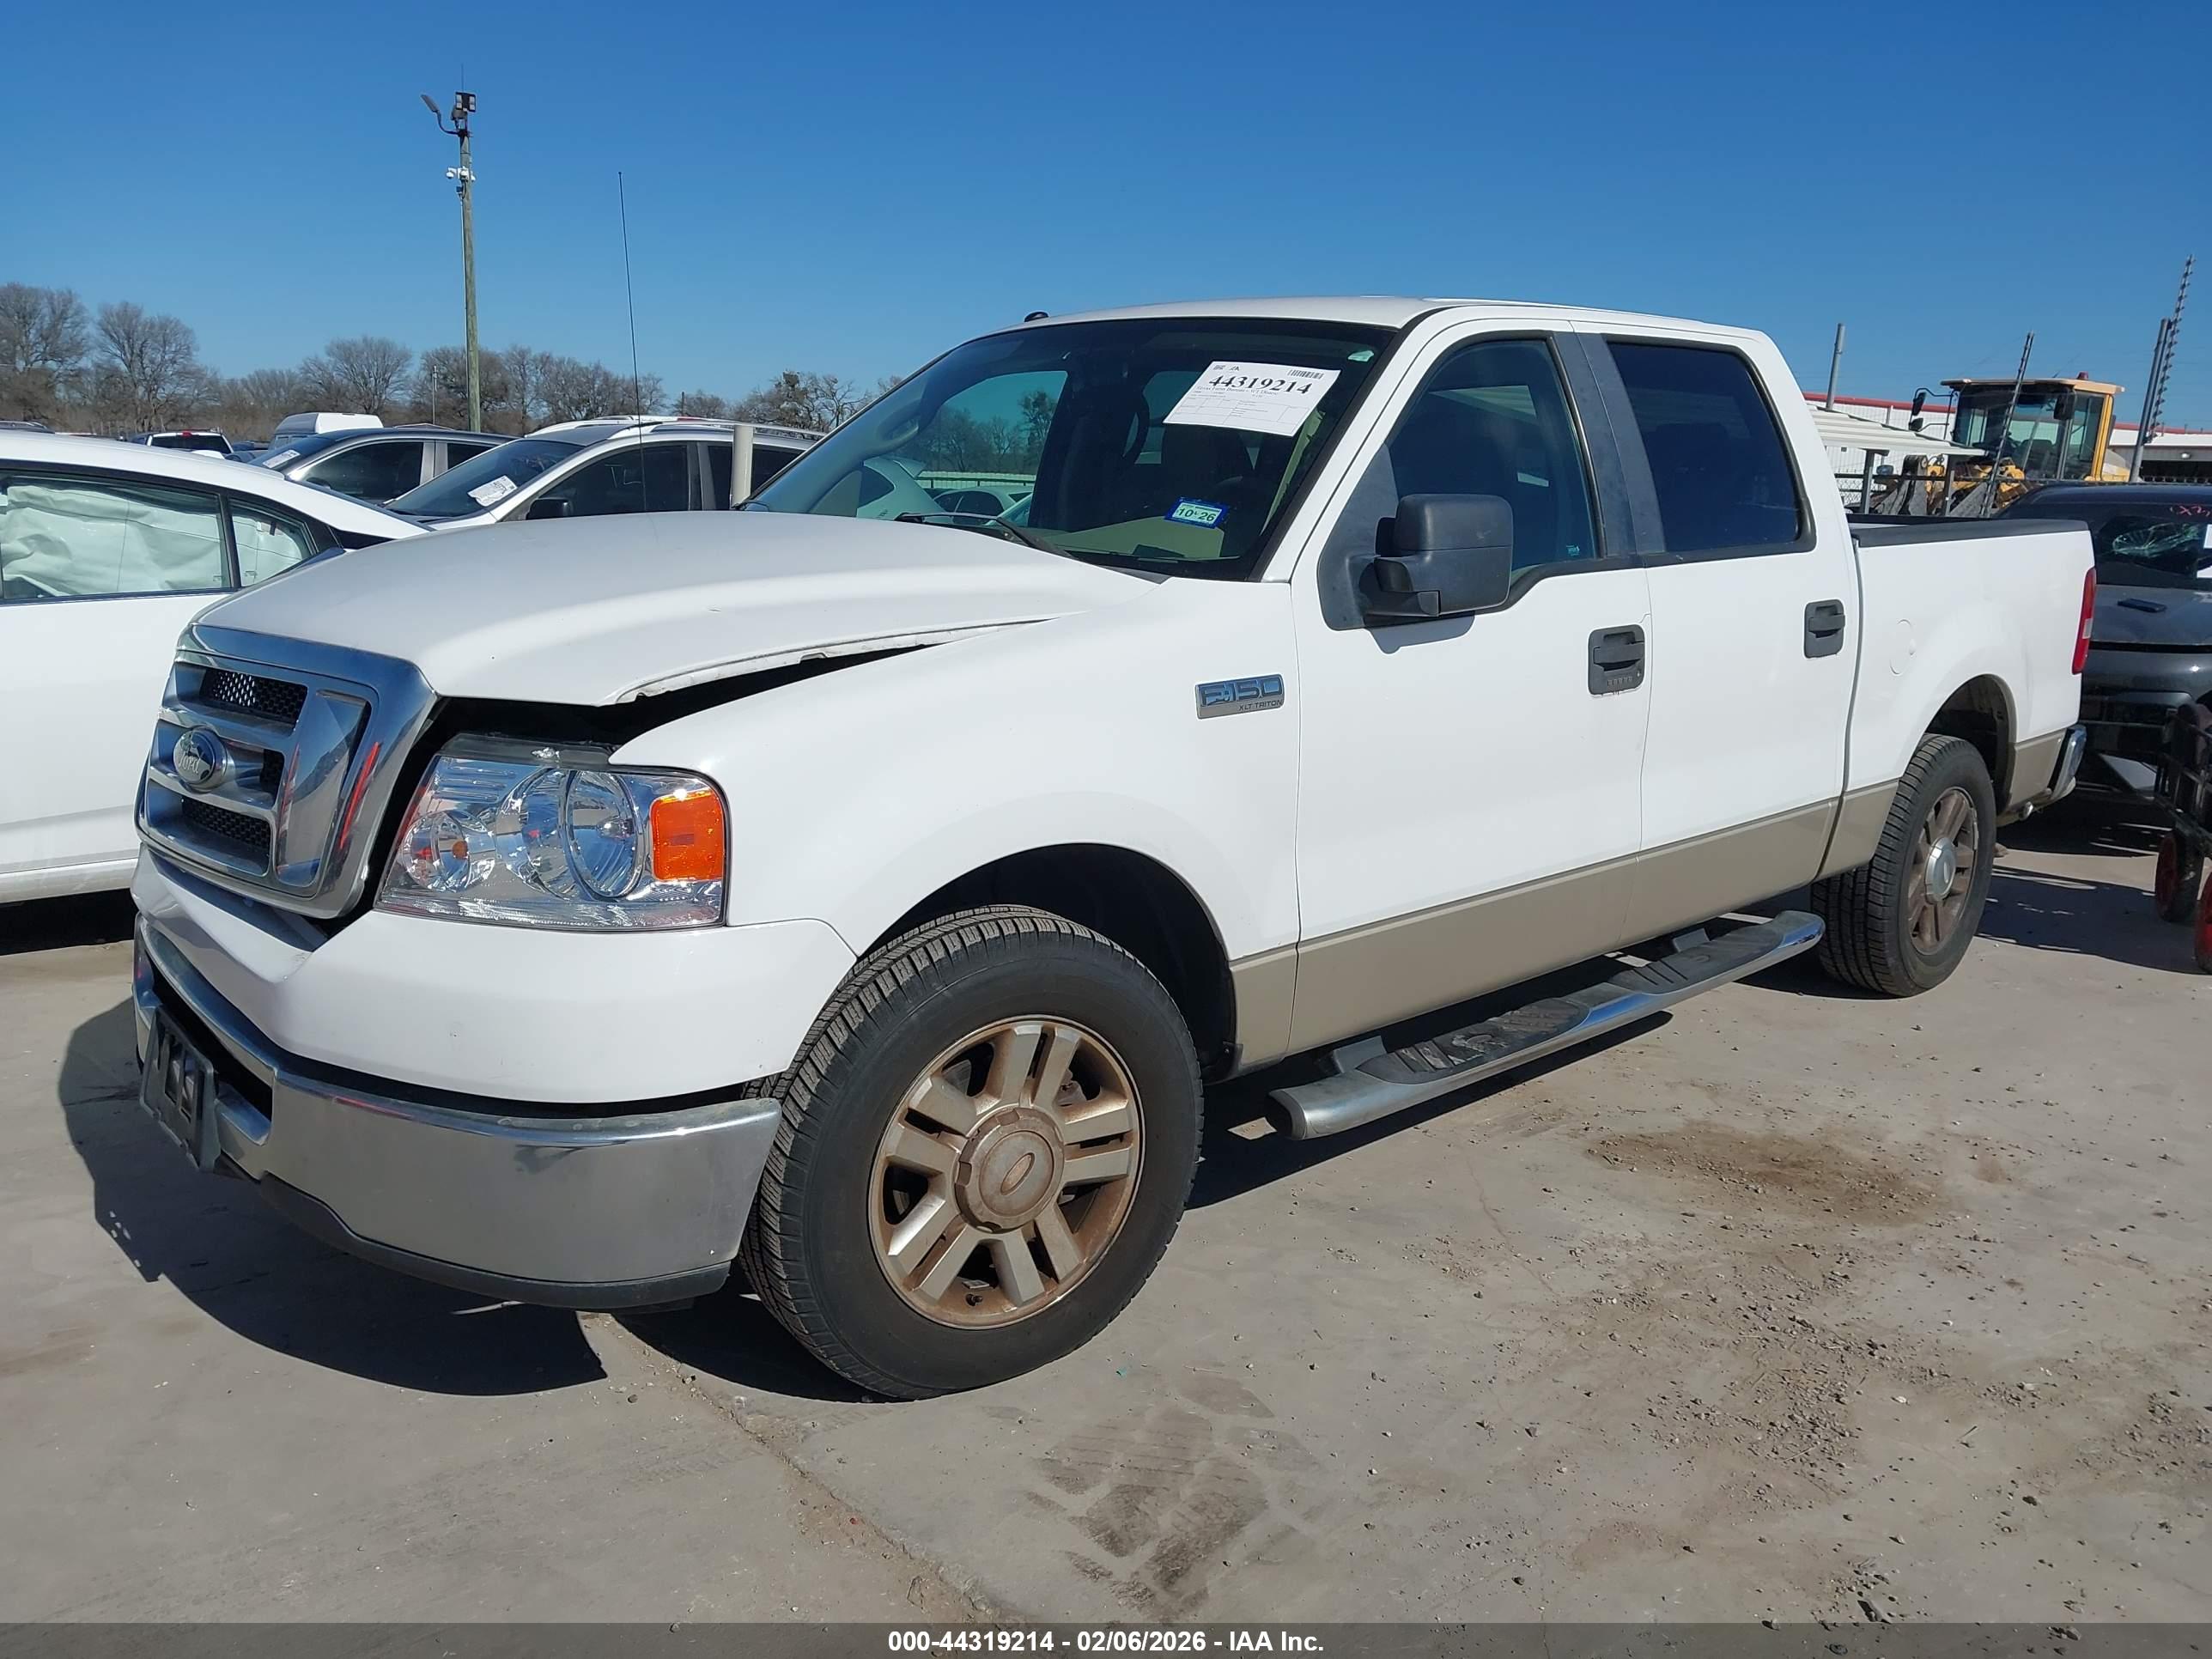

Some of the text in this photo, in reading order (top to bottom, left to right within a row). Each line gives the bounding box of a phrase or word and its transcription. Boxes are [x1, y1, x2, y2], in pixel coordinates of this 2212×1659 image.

[1209, 374, 1313, 394] 44319214
[1178, 507, 1217, 522] 10 26
[1238, 699, 1283, 712] XLT TRITON
